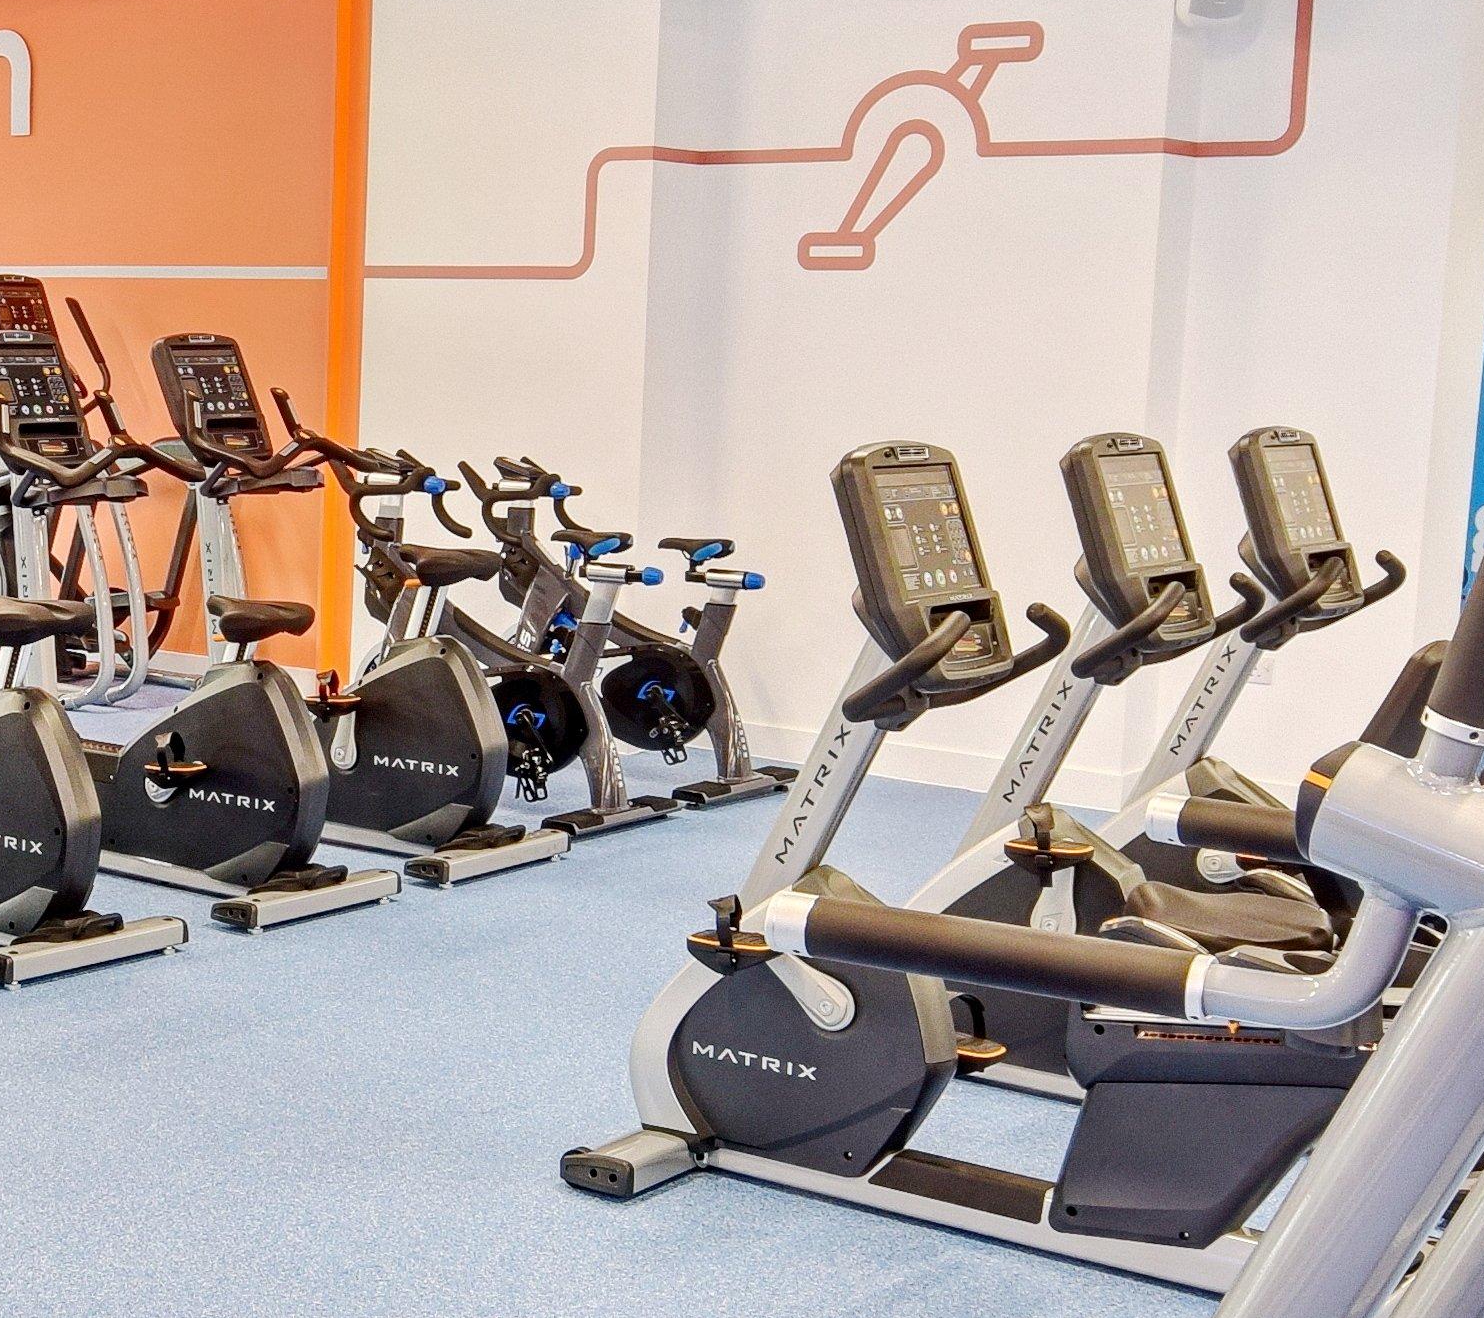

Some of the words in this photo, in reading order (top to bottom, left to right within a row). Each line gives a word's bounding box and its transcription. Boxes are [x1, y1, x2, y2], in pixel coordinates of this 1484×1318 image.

[205, 541, 218, 634] MTRIX
[1003, 679, 1074, 804] MATRIX
[1168, 644, 1238, 756] MATRIX
[188, 787, 277, 813] MATRIX
[373, 753, 460, 777] MATRIX
[774, 723, 853, 865] MATRIX
[692, 1040, 818, 1082] MATRIX
